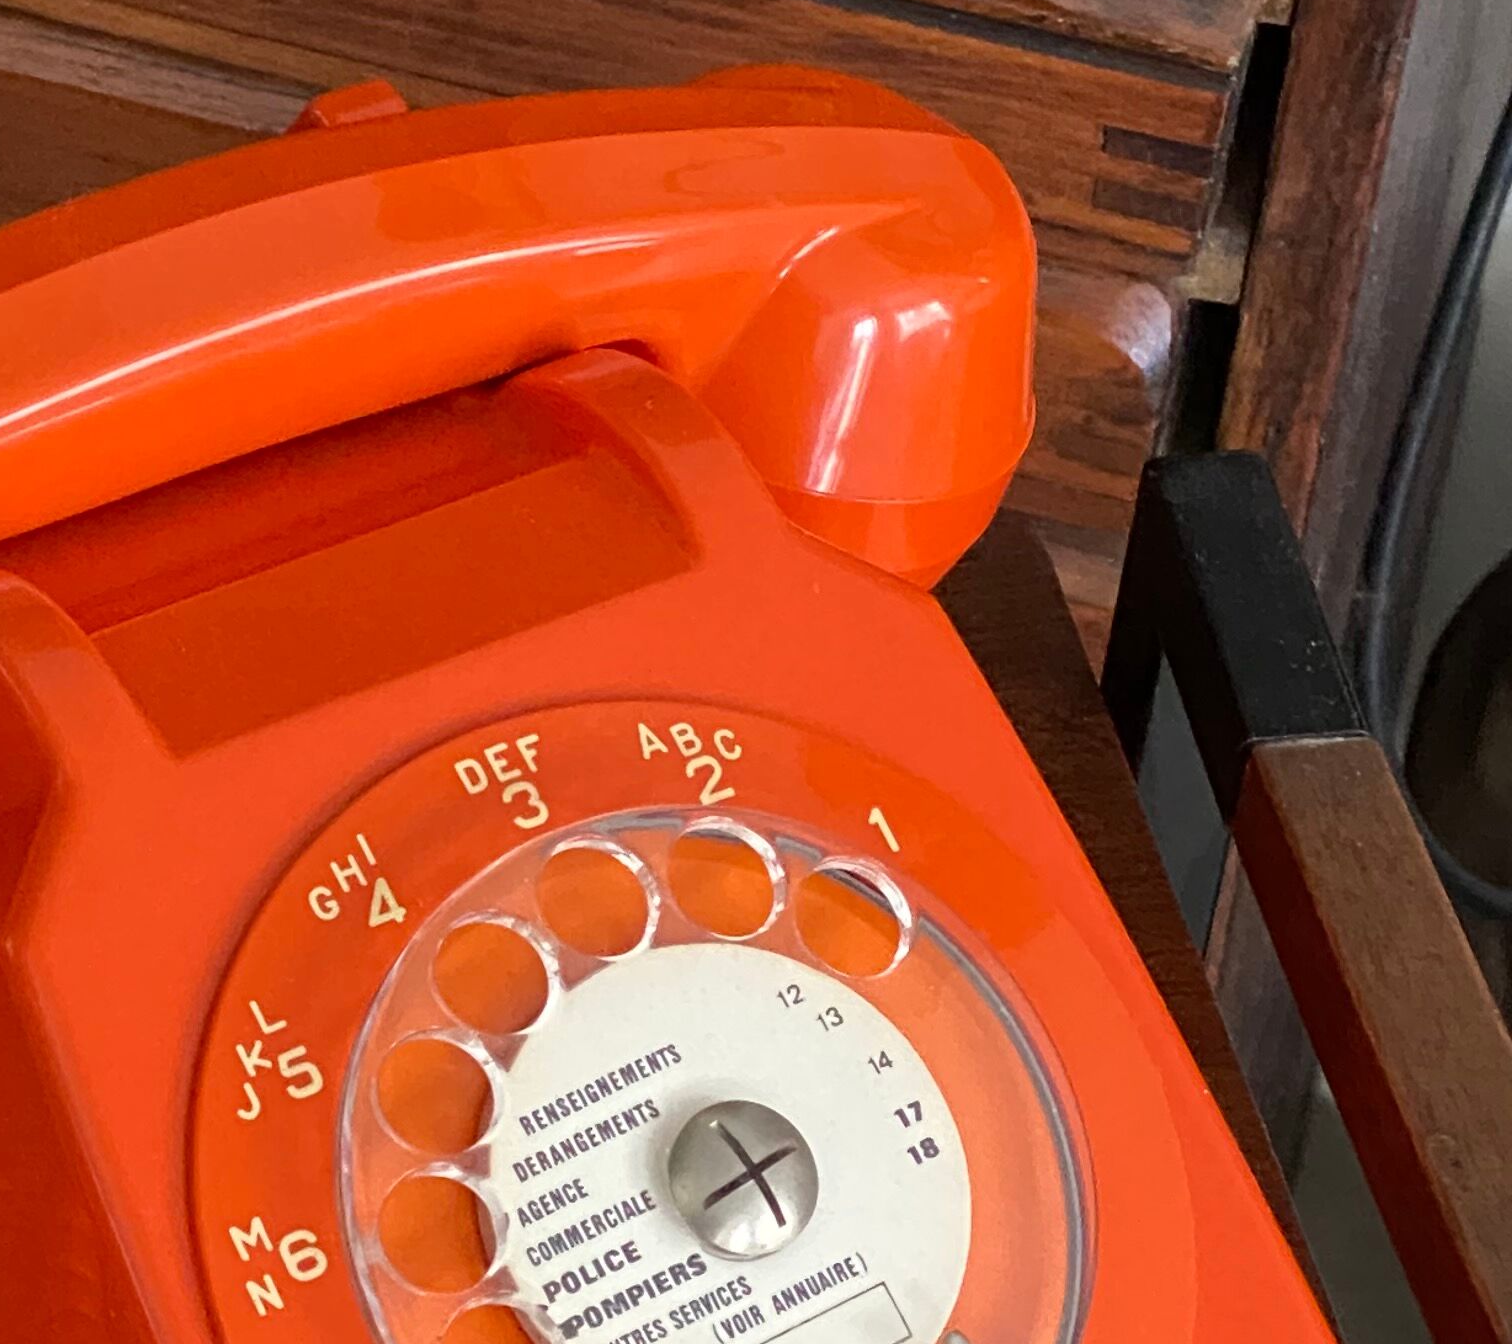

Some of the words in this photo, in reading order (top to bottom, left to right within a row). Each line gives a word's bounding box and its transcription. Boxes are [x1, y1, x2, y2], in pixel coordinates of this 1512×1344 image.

[454, 733, 543, 796] DEF
[637, 722, 744, 761] ABC
[502, 781, 549, 829] 3
[685, 756, 736, 805] 2
[867, 806, 900, 853] 1
[367, 877, 407, 928] 4
[777, 984, 806, 1009] 12
[816, 1006, 845, 1032] 13
[277, 1045, 324, 1099] 5
[867, 1050, 894, 1075] 14
[519, 1043, 683, 1137] RENSEIGNEMENTS
[893, 1100, 923, 1129] 17
[512, 1098, 661, 1184] DERANGEMENTS
[906, 1136, 940, 1165] 18
[516, 1177, 590, 1228] AGENCE
[525, 1189, 658, 1267] COMMERCIALE
[278, 1229, 328, 1282] 6
[542, 1239, 643, 1304] POLICE
[558, 1252, 708, 1340] POMPIERS
[669, 1275, 753, 1330] SERVICES
[712, 1304, 766, 1344] (VOIR
[772, 1251, 869, 1315] ANNUAIRE)
